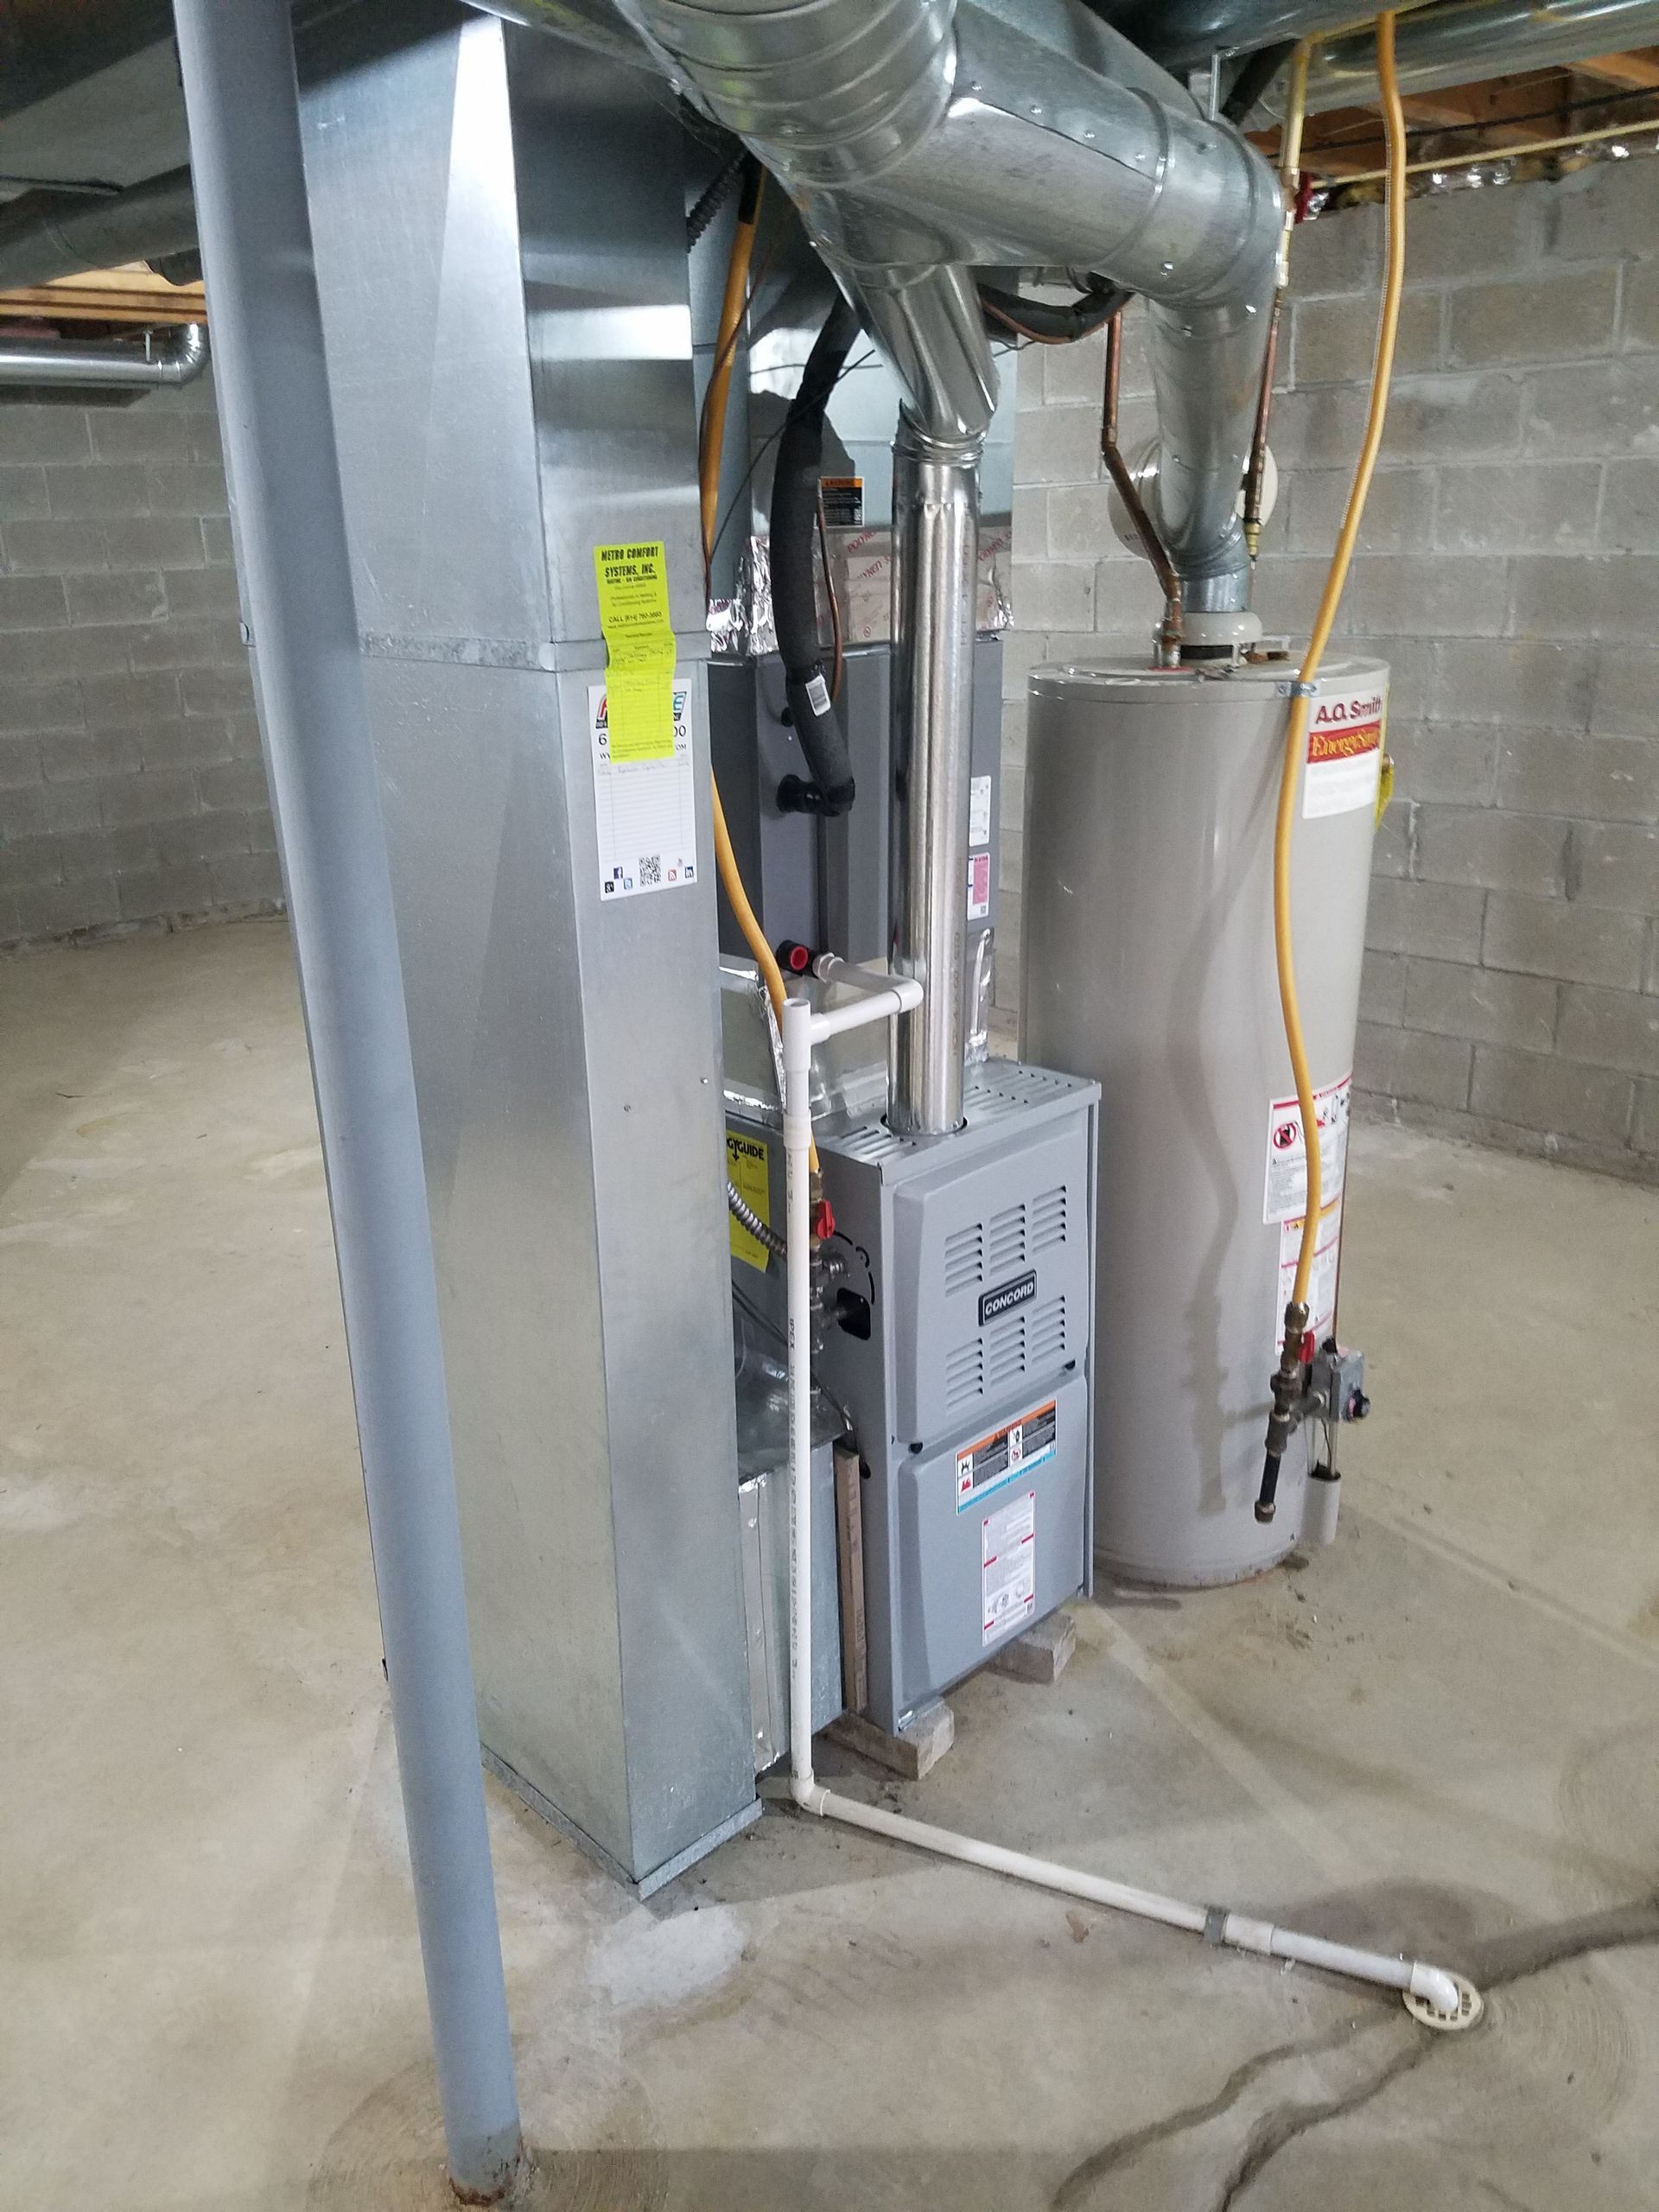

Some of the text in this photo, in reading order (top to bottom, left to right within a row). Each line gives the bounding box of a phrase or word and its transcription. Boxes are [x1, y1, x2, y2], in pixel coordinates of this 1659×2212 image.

[601, 546, 658, 561] METRO COMFORT
[986, 1281, 1034, 1315] CONCORD
